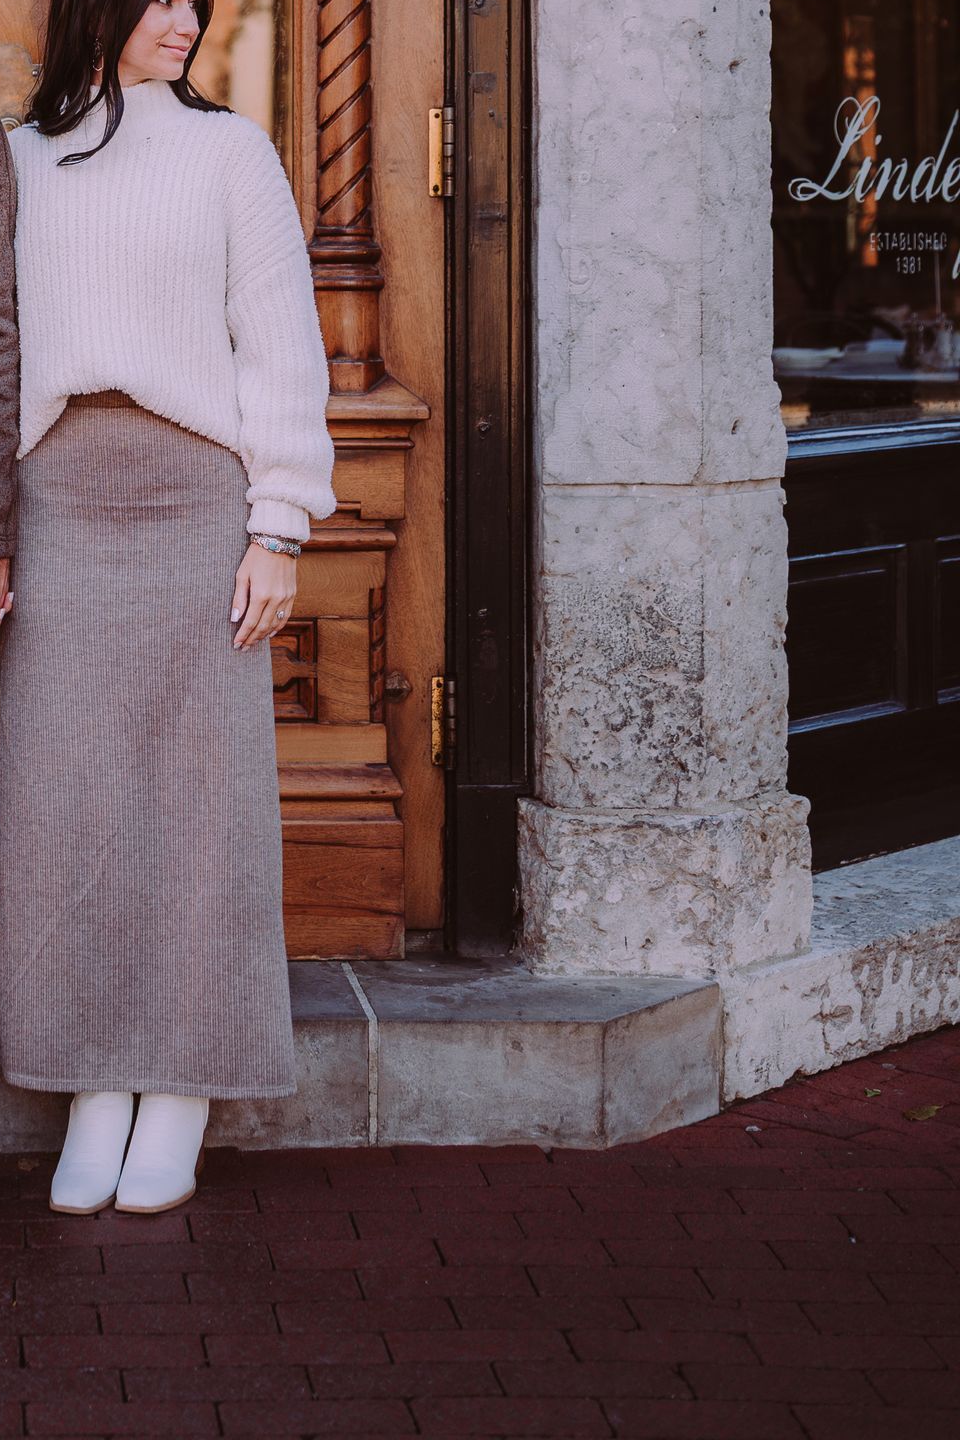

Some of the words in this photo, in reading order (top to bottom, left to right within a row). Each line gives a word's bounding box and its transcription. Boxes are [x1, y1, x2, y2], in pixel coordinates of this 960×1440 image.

[788, 95, 960, 280] Linde
[869, 232, 947, 252] ESTABLISHED
[896, 256, 922, 274] 1981
